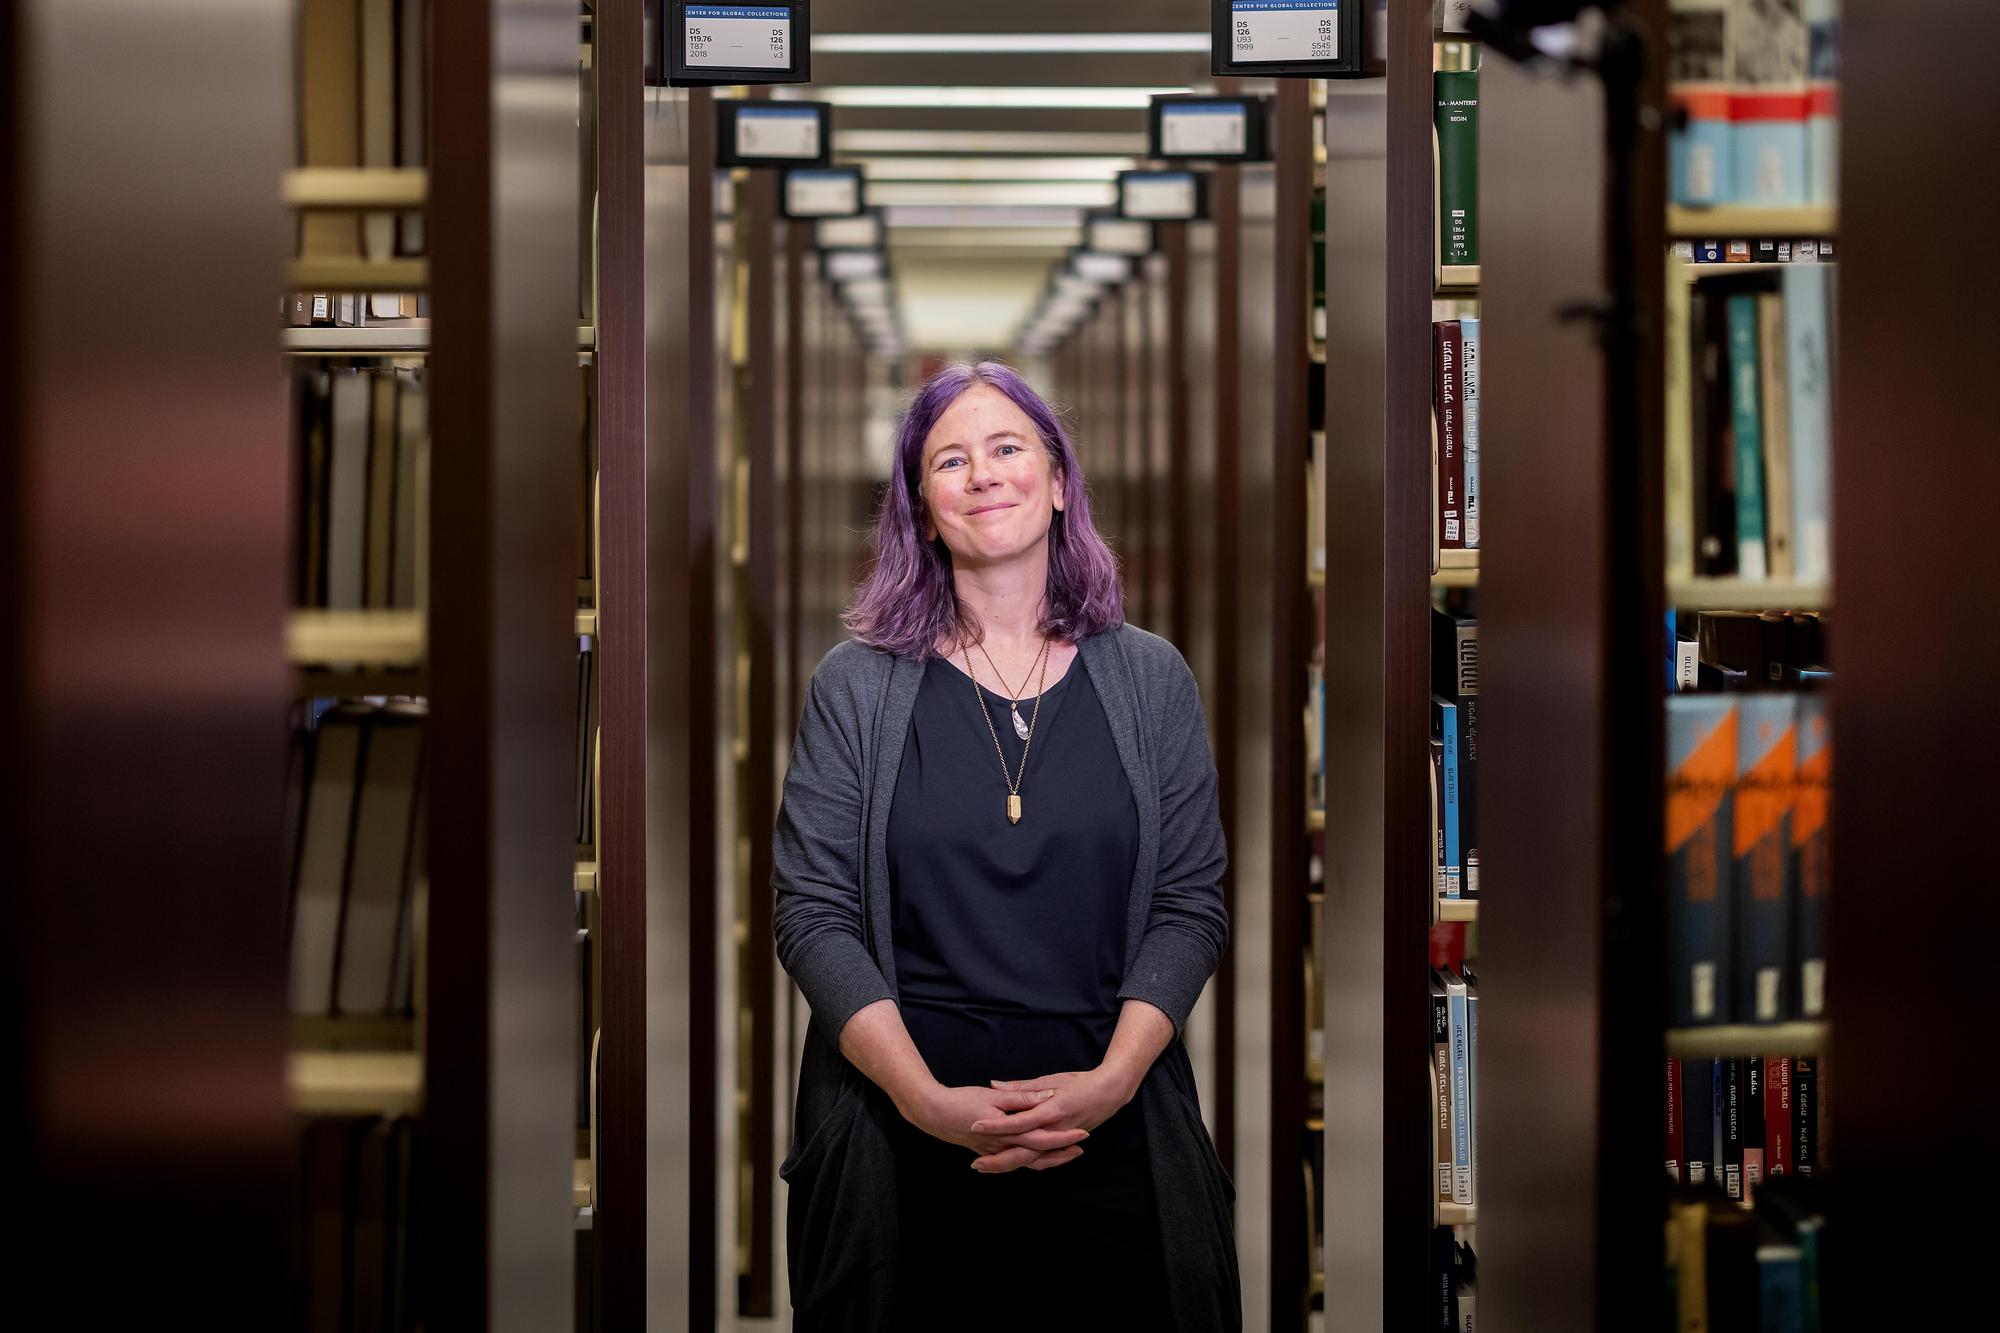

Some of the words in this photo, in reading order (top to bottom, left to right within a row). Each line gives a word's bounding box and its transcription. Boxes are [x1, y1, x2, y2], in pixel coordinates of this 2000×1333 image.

[770, 36, 783, 44] 126
[690, 50, 708, 58] 2018
[773, 51, 783, 59] v.3
[1442, 341, 1453, 371] העשור
[1463, 341, 1475, 368] העשור
[1460, 639, 1479, 688] תקומה
